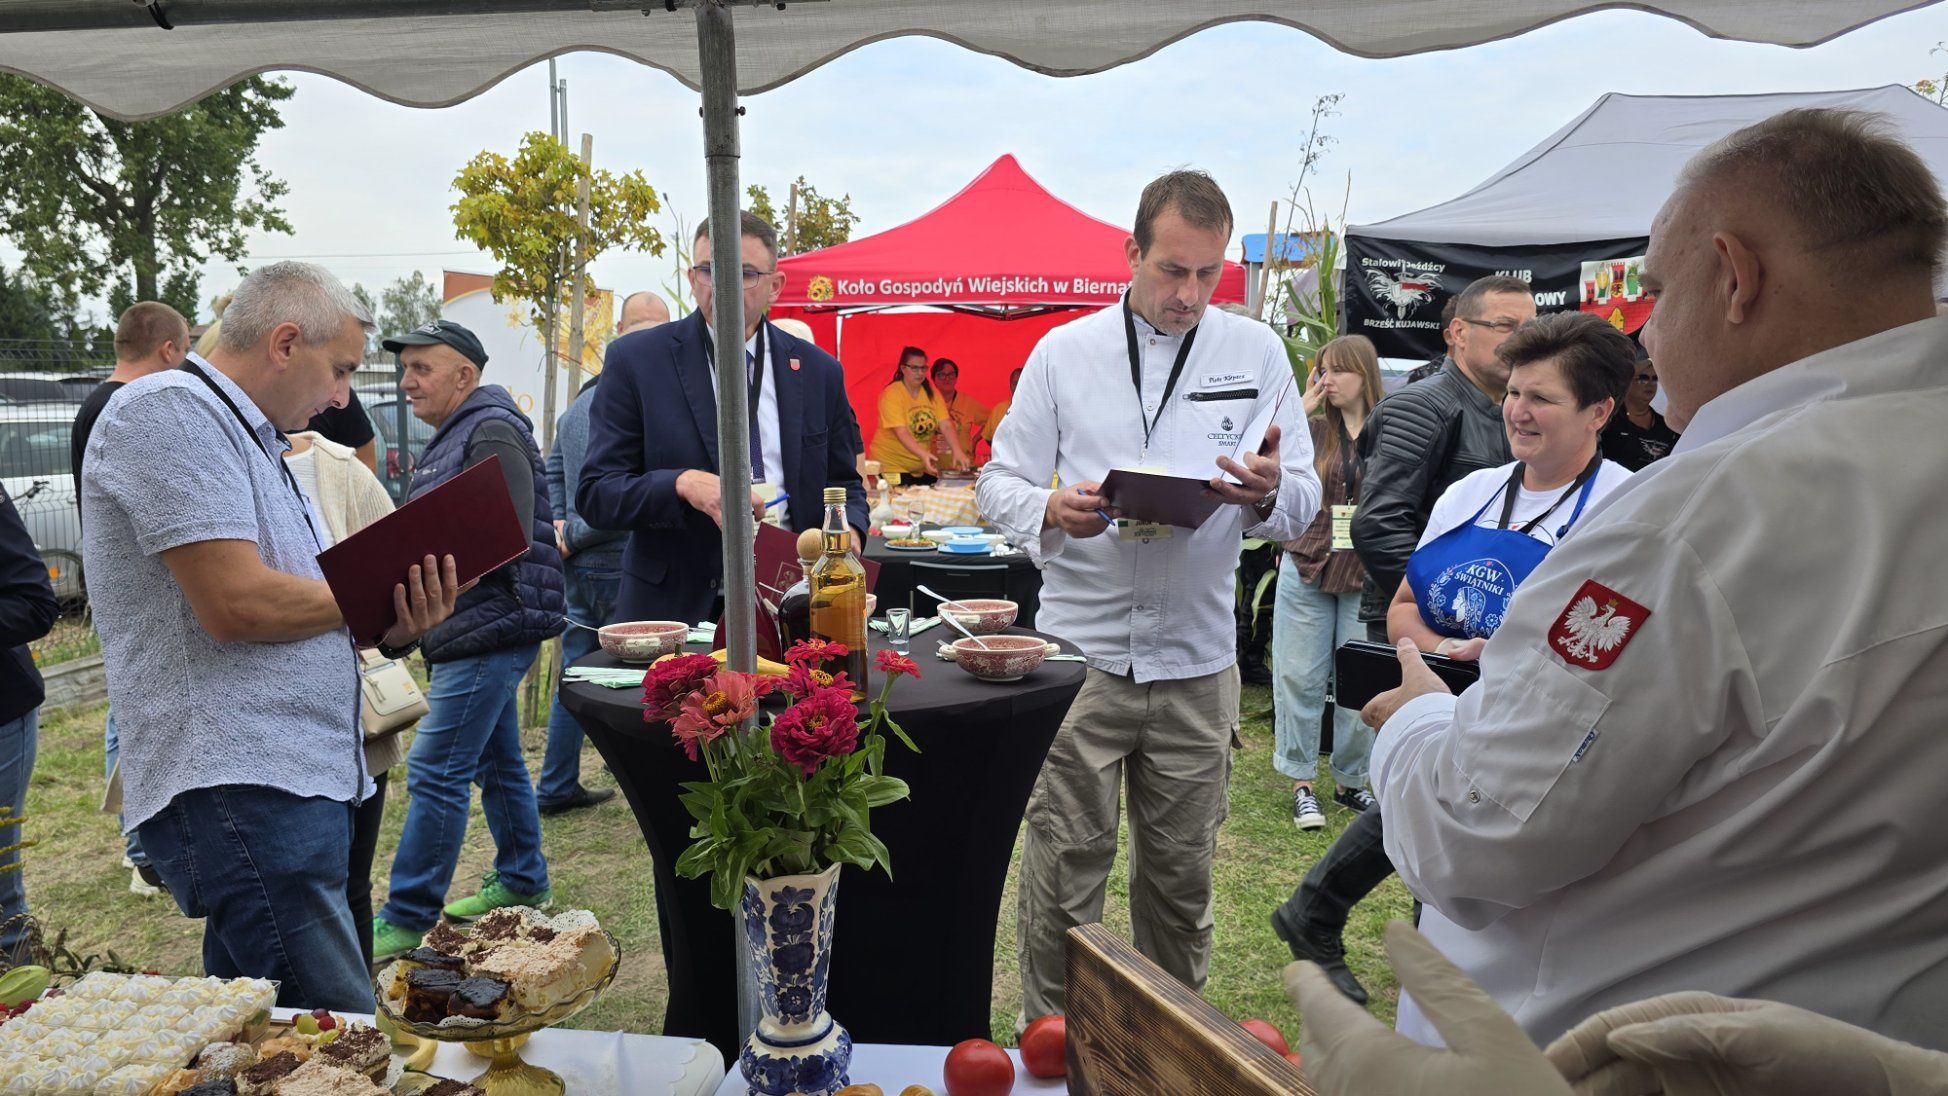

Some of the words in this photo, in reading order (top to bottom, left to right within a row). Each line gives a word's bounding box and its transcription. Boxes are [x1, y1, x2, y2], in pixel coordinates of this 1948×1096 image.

[837, 278, 876, 295] Koło
[879, 276, 964, 298] Gospodyń
[967, 276, 1049, 296] Wiejskich
[1052, 281, 1069, 293] w
[1073, 277, 1131, 295] Bierna
[1363, 317, 1395, 329] BRZEŚĆ
[1395, 320, 1441, 330] KUJAWSKI
[1454, 570, 1505, 596] ŚWIĄTNIKI
[1466, 564, 1503, 583] KGW
